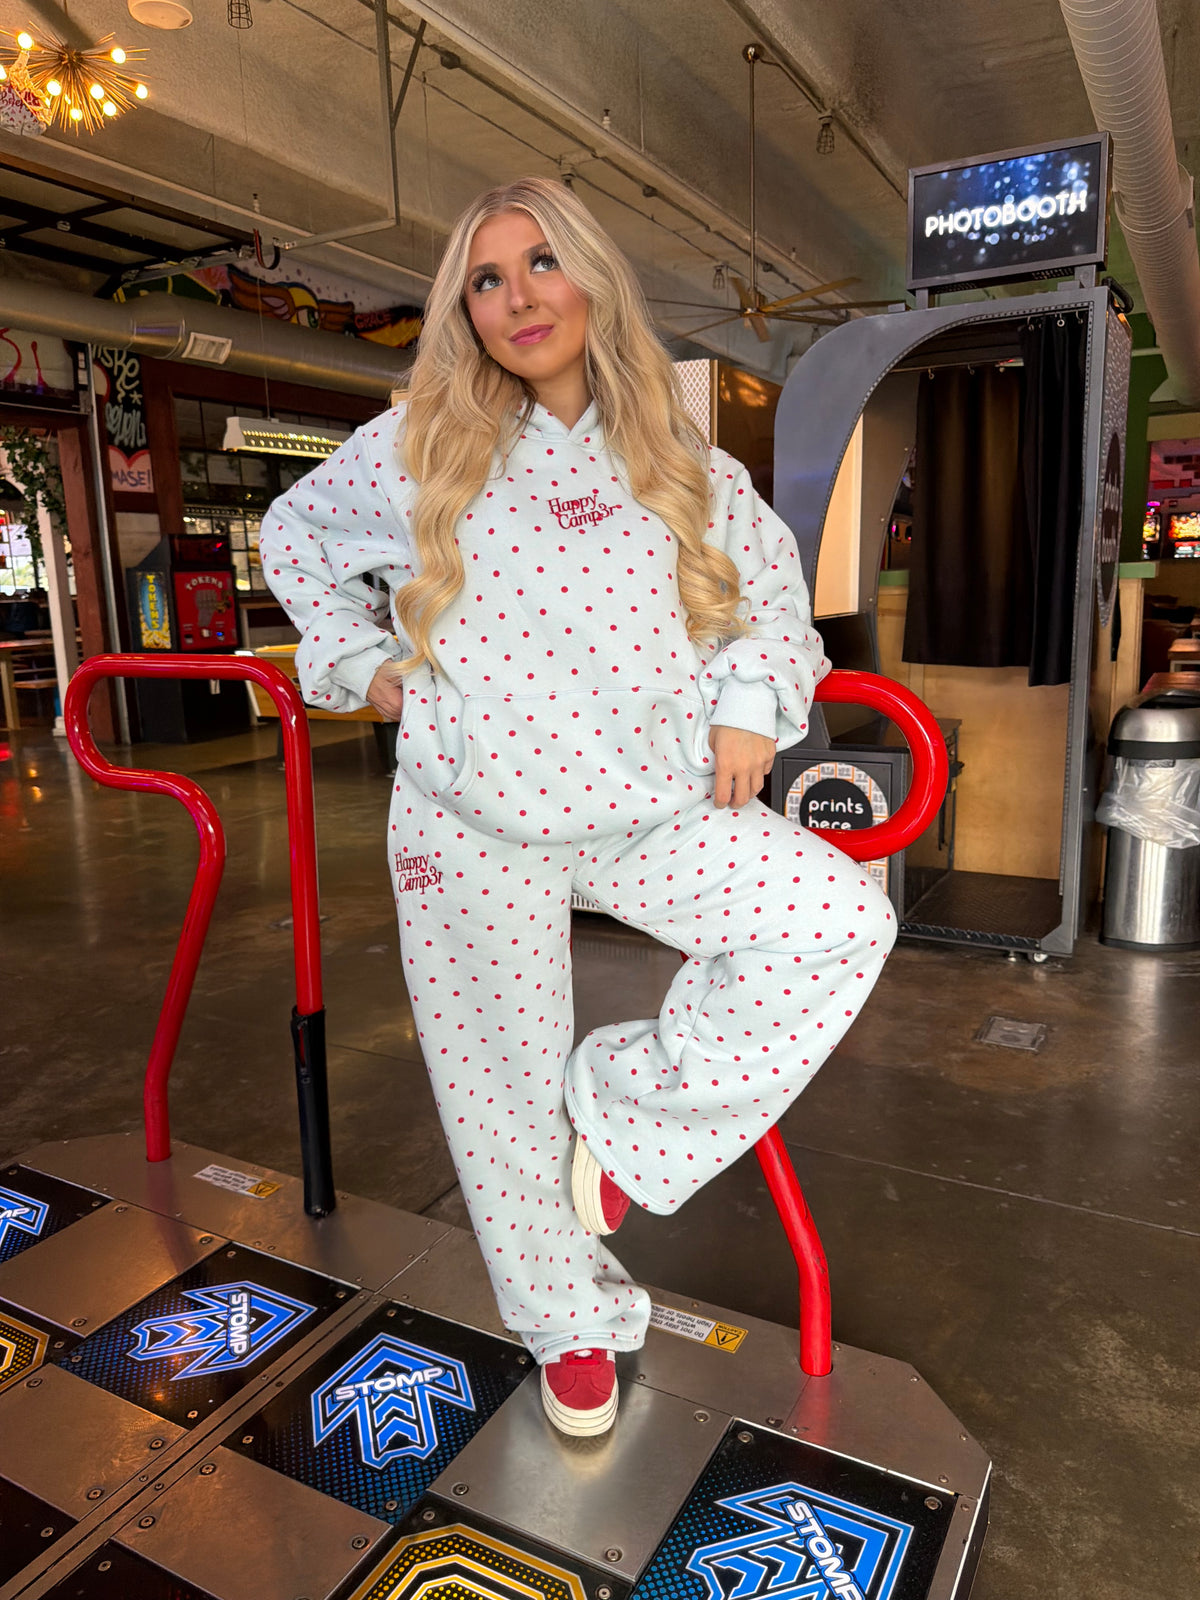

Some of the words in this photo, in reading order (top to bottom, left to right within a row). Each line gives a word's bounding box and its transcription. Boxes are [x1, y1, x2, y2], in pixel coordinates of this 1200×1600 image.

[925, 189, 1088, 238] PHOTOBOOTH
[546, 495, 597, 515] Happy
[558, 503, 617, 529] Camp3r
[185, 576, 223, 591] TOKENS
[146, 575, 160, 629] TOKENS
[808, 797, 864, 814] prints
[394, 852, 430, 876] Happy
[398, 866, 444, 895] Camp3r
[230, 1292, 248, 1355] STOMP
[335, 1367, 443, 1401] STOMP
[786, 1501, 863, 1600] STOMP
